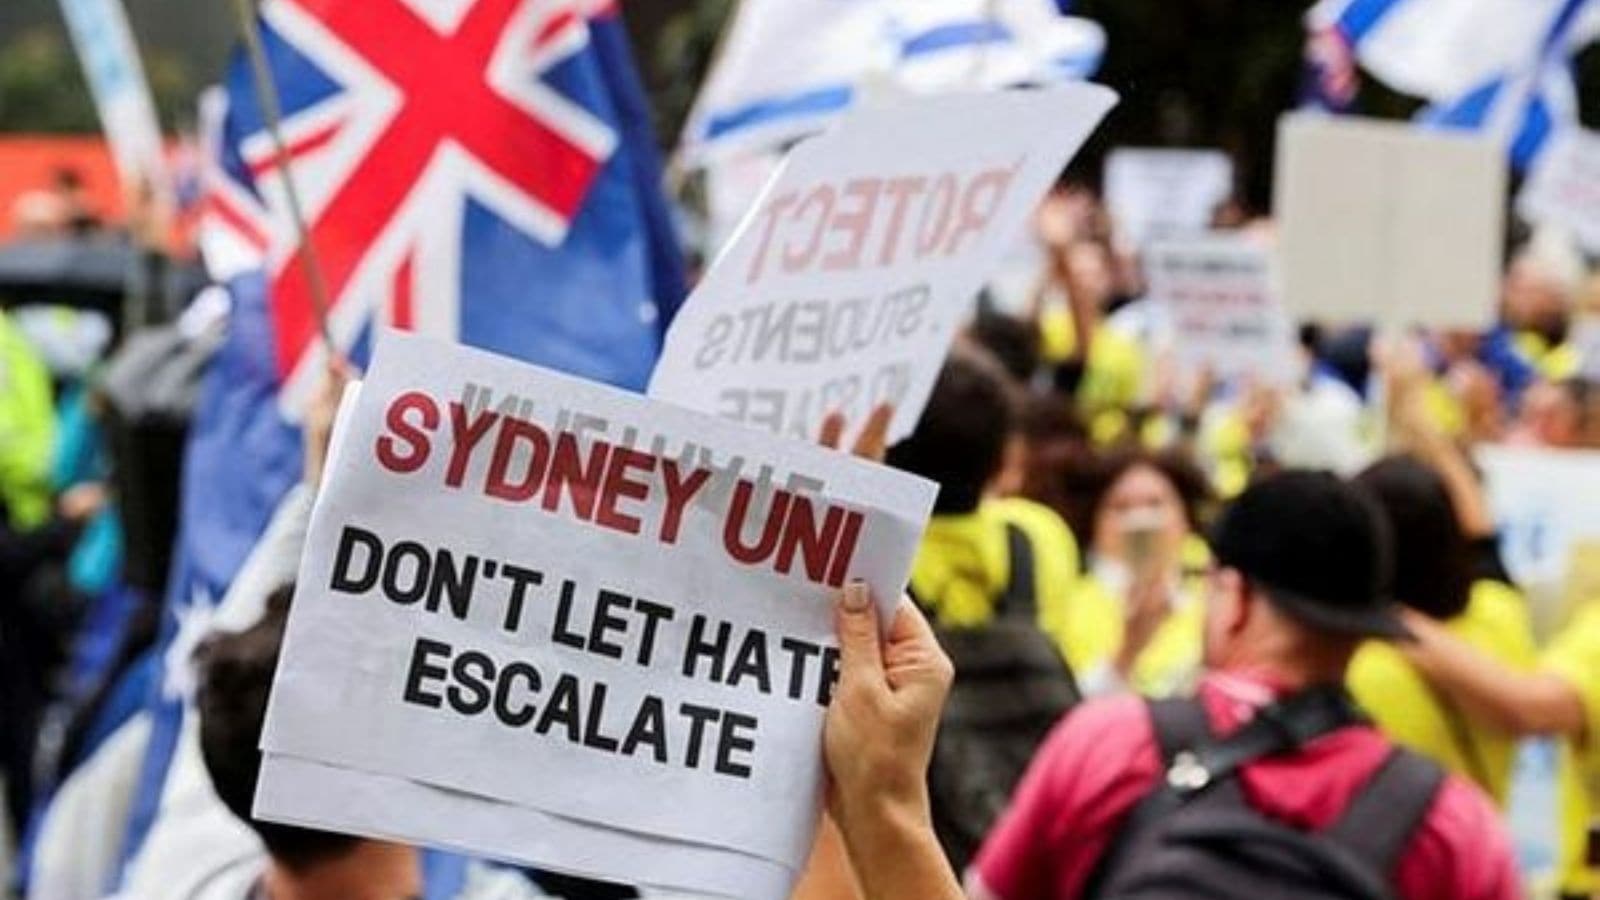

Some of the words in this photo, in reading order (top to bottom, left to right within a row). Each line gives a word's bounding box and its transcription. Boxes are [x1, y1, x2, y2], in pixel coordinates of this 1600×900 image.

[376, 391, 711, 544] SYDNEY
[723, 479, 864, 588] UNI
[330, 525, 542, 631] DON'T
[551, 581, 674, 667] LET
[403, 638, 757, 779] ESCALATE
